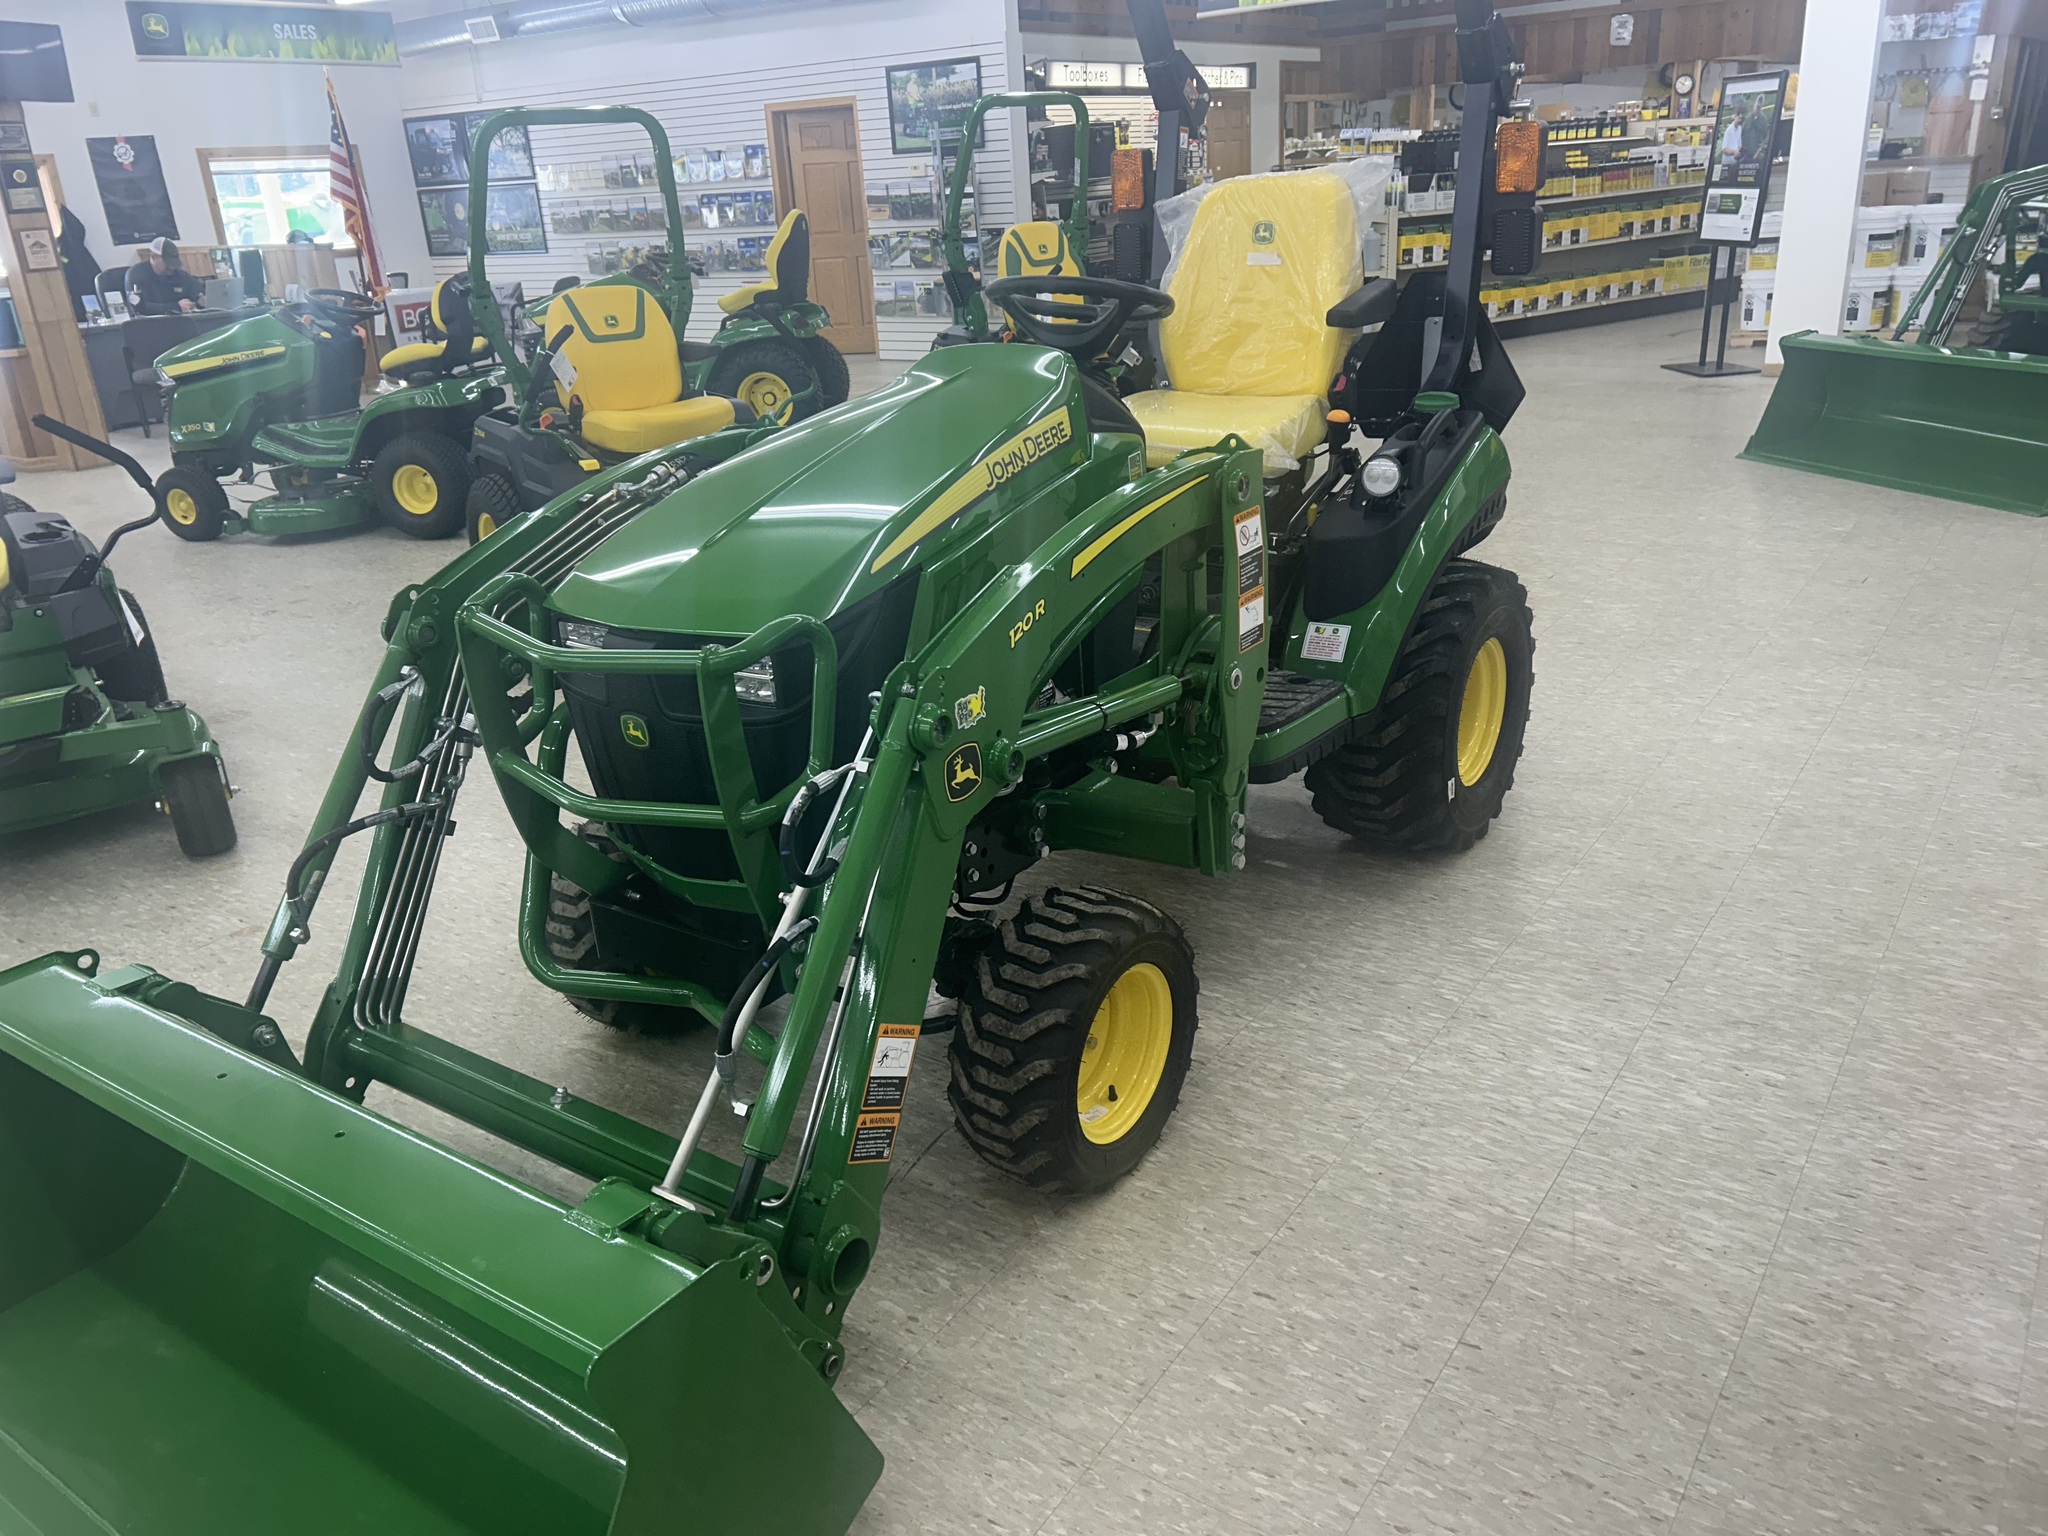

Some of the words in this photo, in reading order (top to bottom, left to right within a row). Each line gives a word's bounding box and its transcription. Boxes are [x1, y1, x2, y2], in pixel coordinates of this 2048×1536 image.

[272, 23, 317, 40] SALES
[1063, 64, 1109, 83] Toolboxes
[221, 355, 240, 366] JOHN
[240, 350, 265, 361] DEERE
[181, 423, 201, 434] X350
[985, 446, 1026, 489] JOHN
[1022, 420, 1069, 460] DEERE
[1239, 506, 1260, 522] WARNING
[1008, 611, 1034, 649] 120
[889, 1027, 916, 1036] WARNING
[868, 1116, 896, 1126] WARNING
